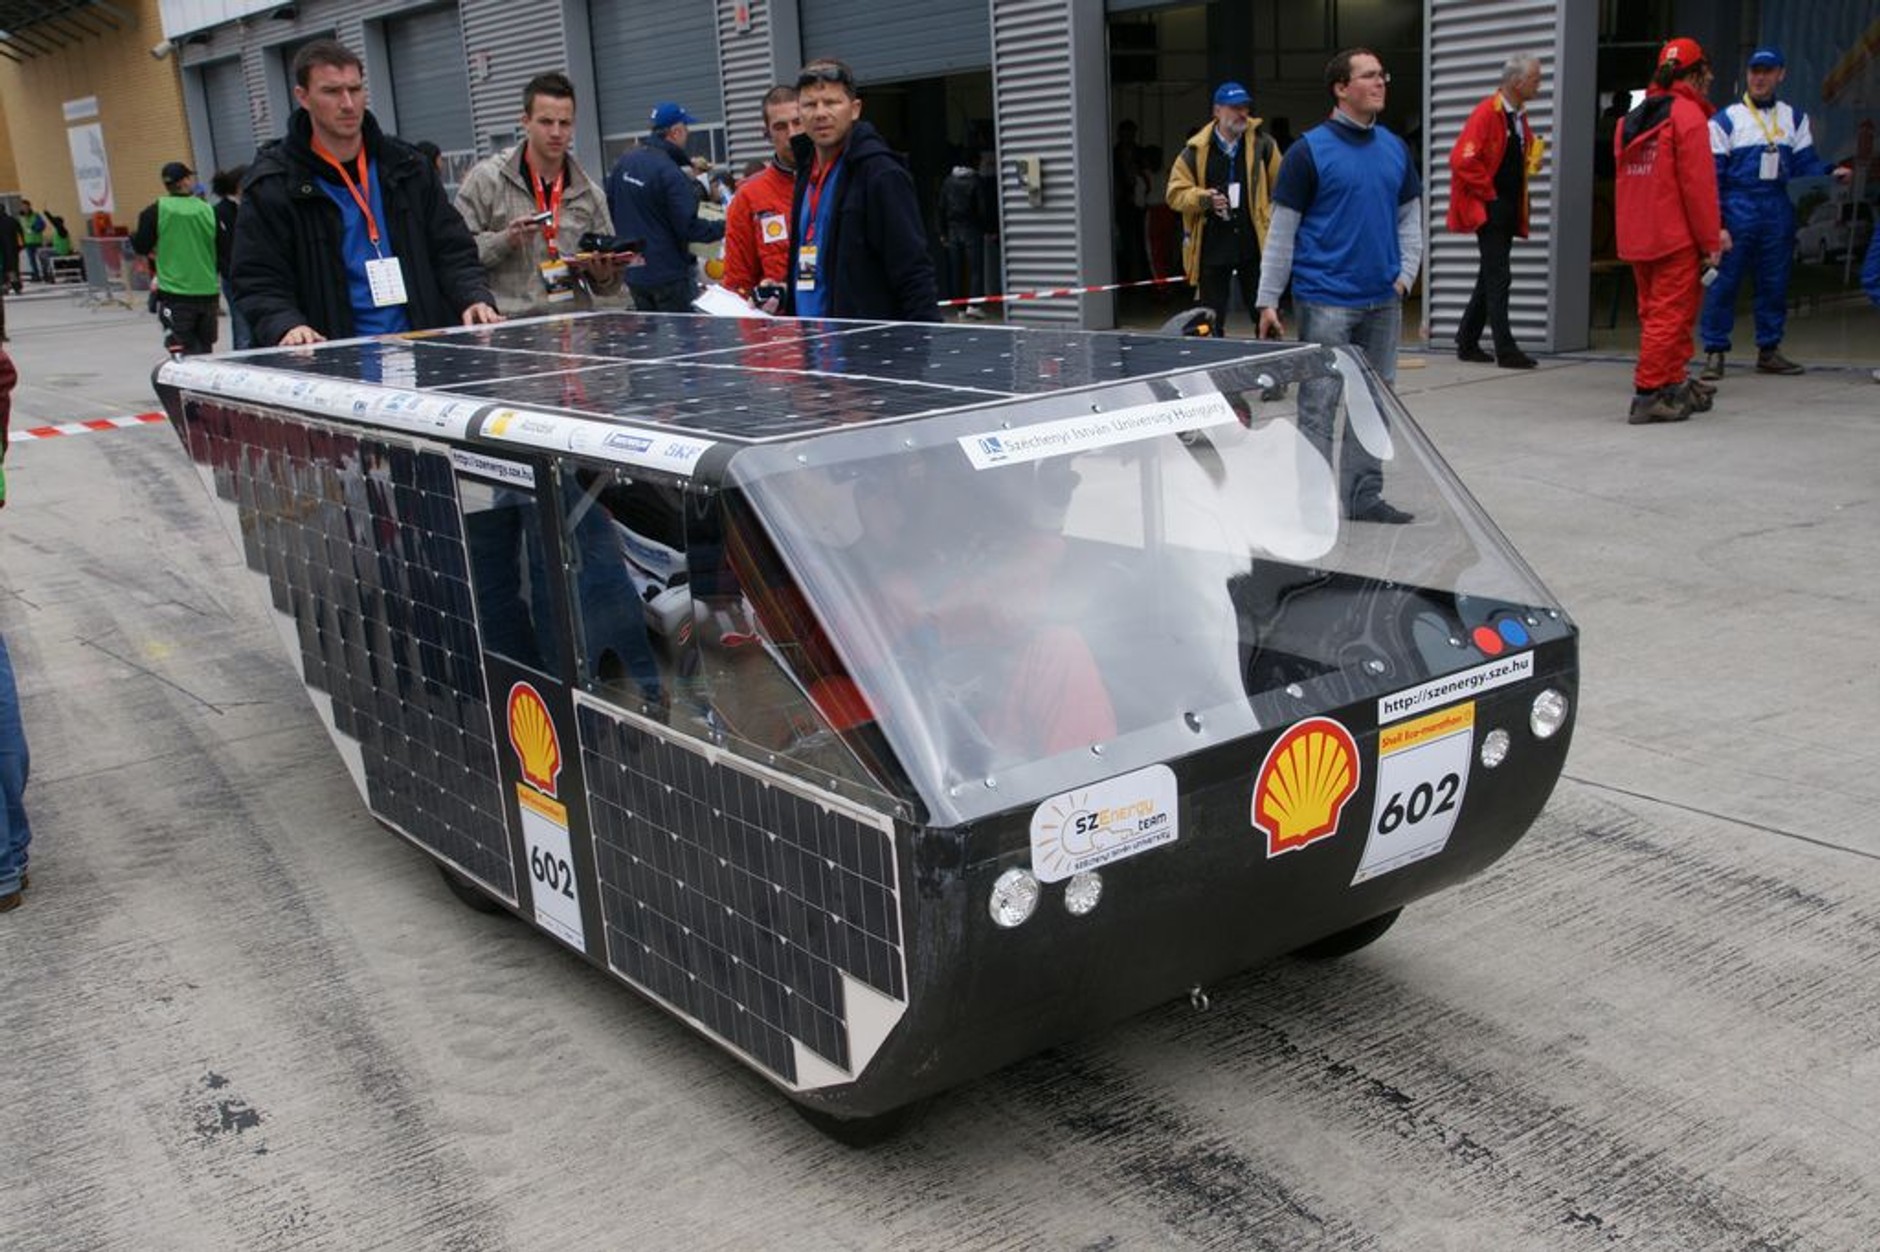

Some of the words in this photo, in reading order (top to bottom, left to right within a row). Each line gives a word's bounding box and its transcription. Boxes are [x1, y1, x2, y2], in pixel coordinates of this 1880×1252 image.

[1383, 659, 1529, 714] http://szenergy.sze.hu
[1377, 773, 1460, 835] 602
[532, 846, 575, 900] 602
